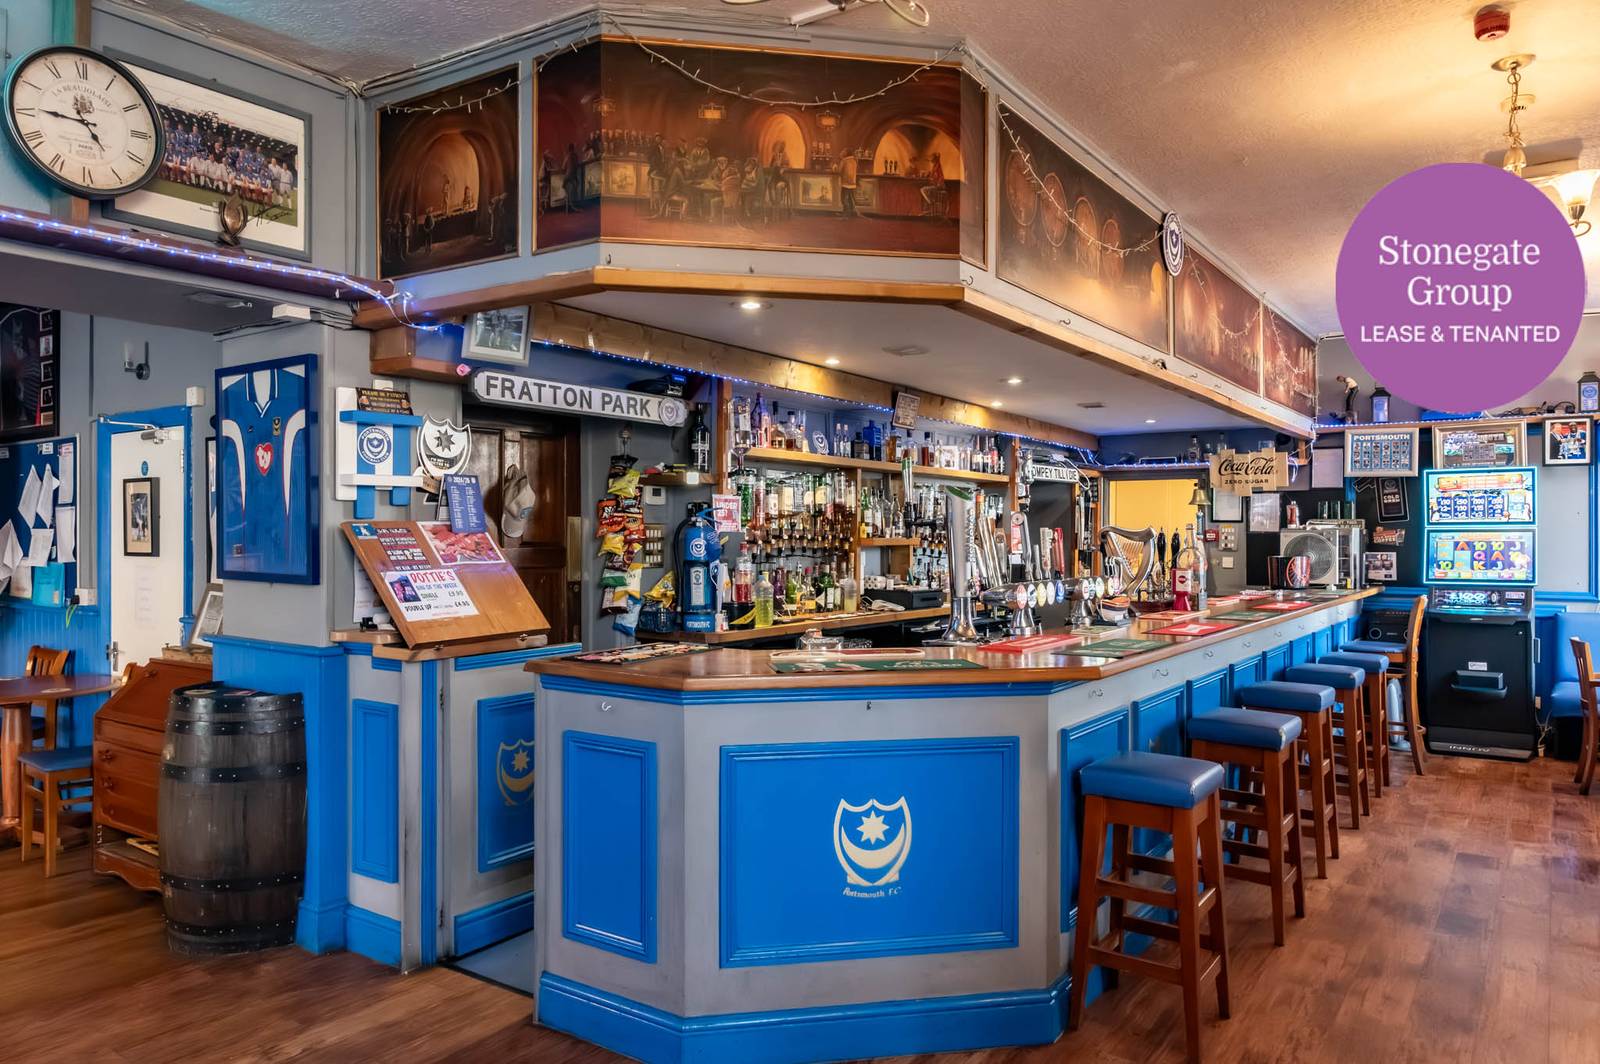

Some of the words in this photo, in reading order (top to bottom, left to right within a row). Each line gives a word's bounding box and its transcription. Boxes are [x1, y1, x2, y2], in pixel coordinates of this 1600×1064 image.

[486, 375, 593, 410] FRATTON
[601, 392, 651, 418] PARK
[1354, 433, 1410, 441] PORTSMOUTH
[1033, 466, 1053, 478] OMPEY
[1218, 456, 1275, 476] Coca-Cola
